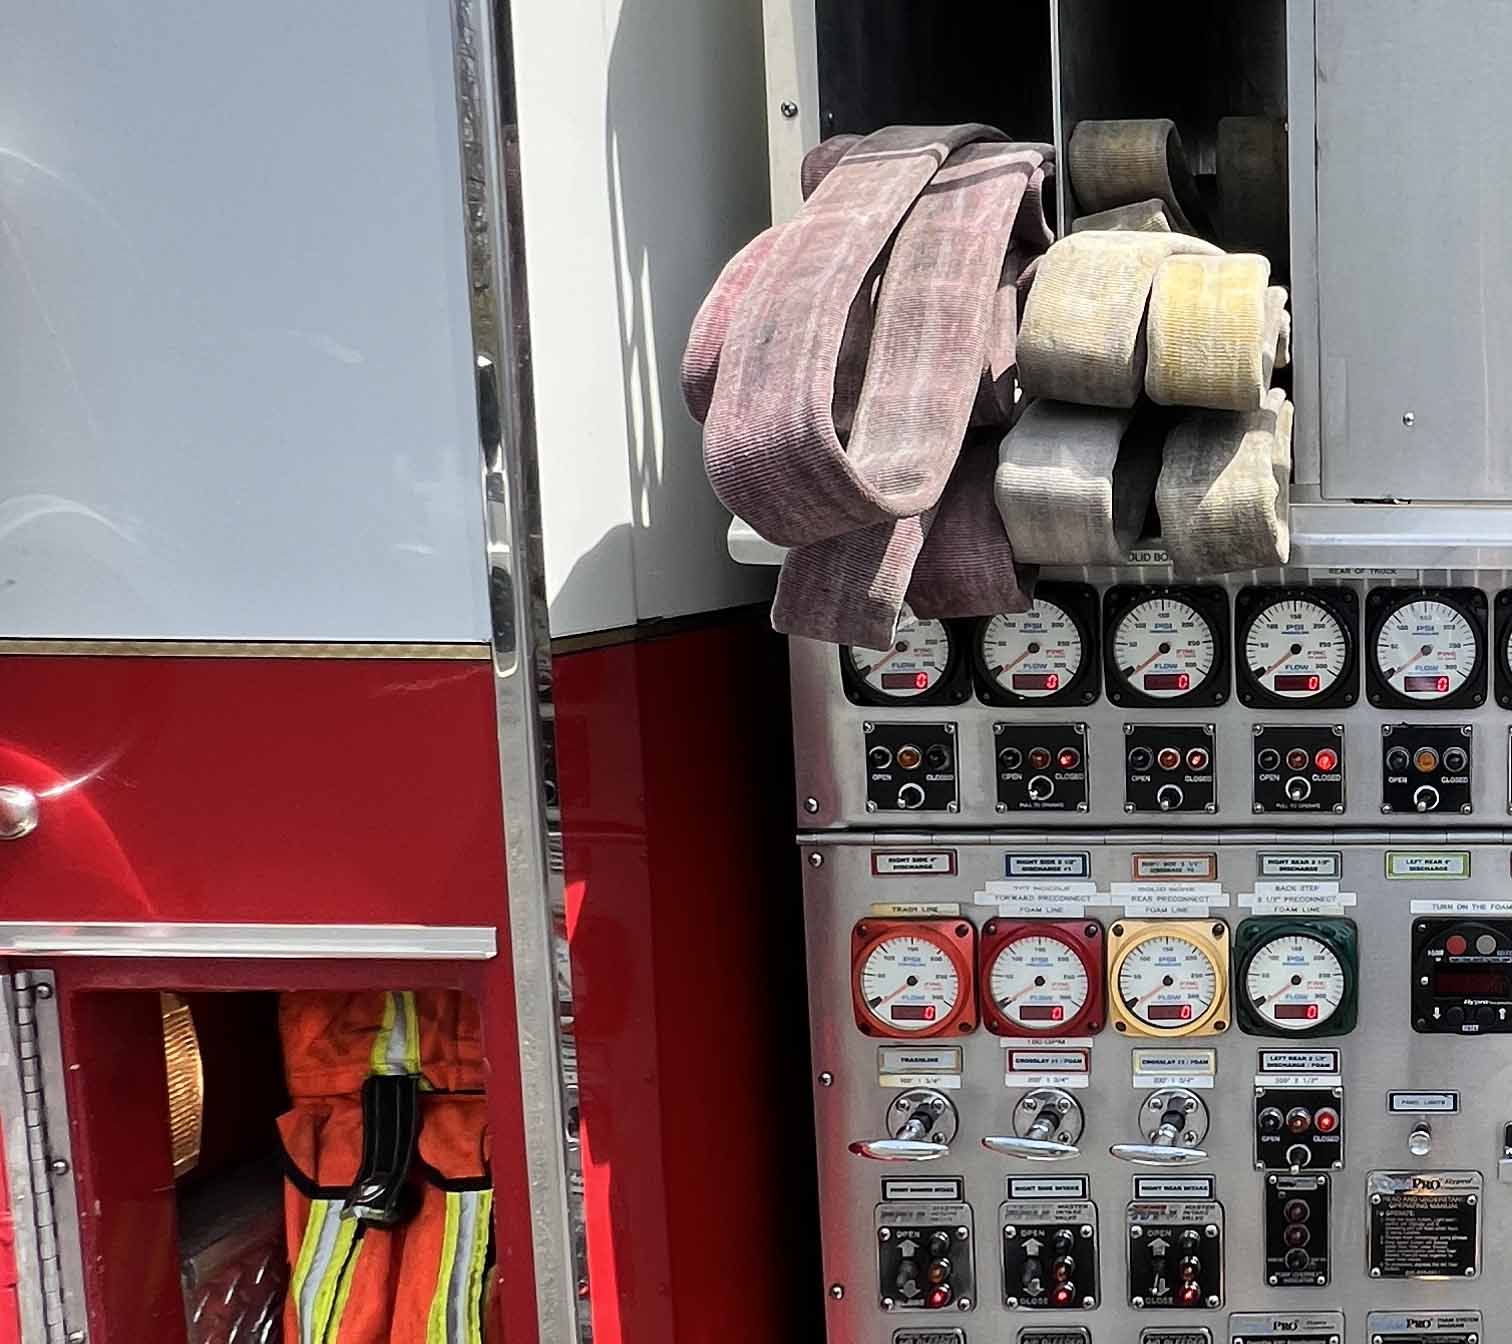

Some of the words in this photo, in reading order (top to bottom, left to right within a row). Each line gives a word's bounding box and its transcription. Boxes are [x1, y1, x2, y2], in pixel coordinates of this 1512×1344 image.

[1127, 552, 1151, 562] OLID
[1154, 552, 1169, 562] BO
[1308, 676, 1318, 690] 0
[924, 1006, 934, 1020] 0
[1052, 1007, 1062, 1020] 0
[1181, 1006, 1190, 1019] 0
[1307, 1006, 1317, 1019] 0
